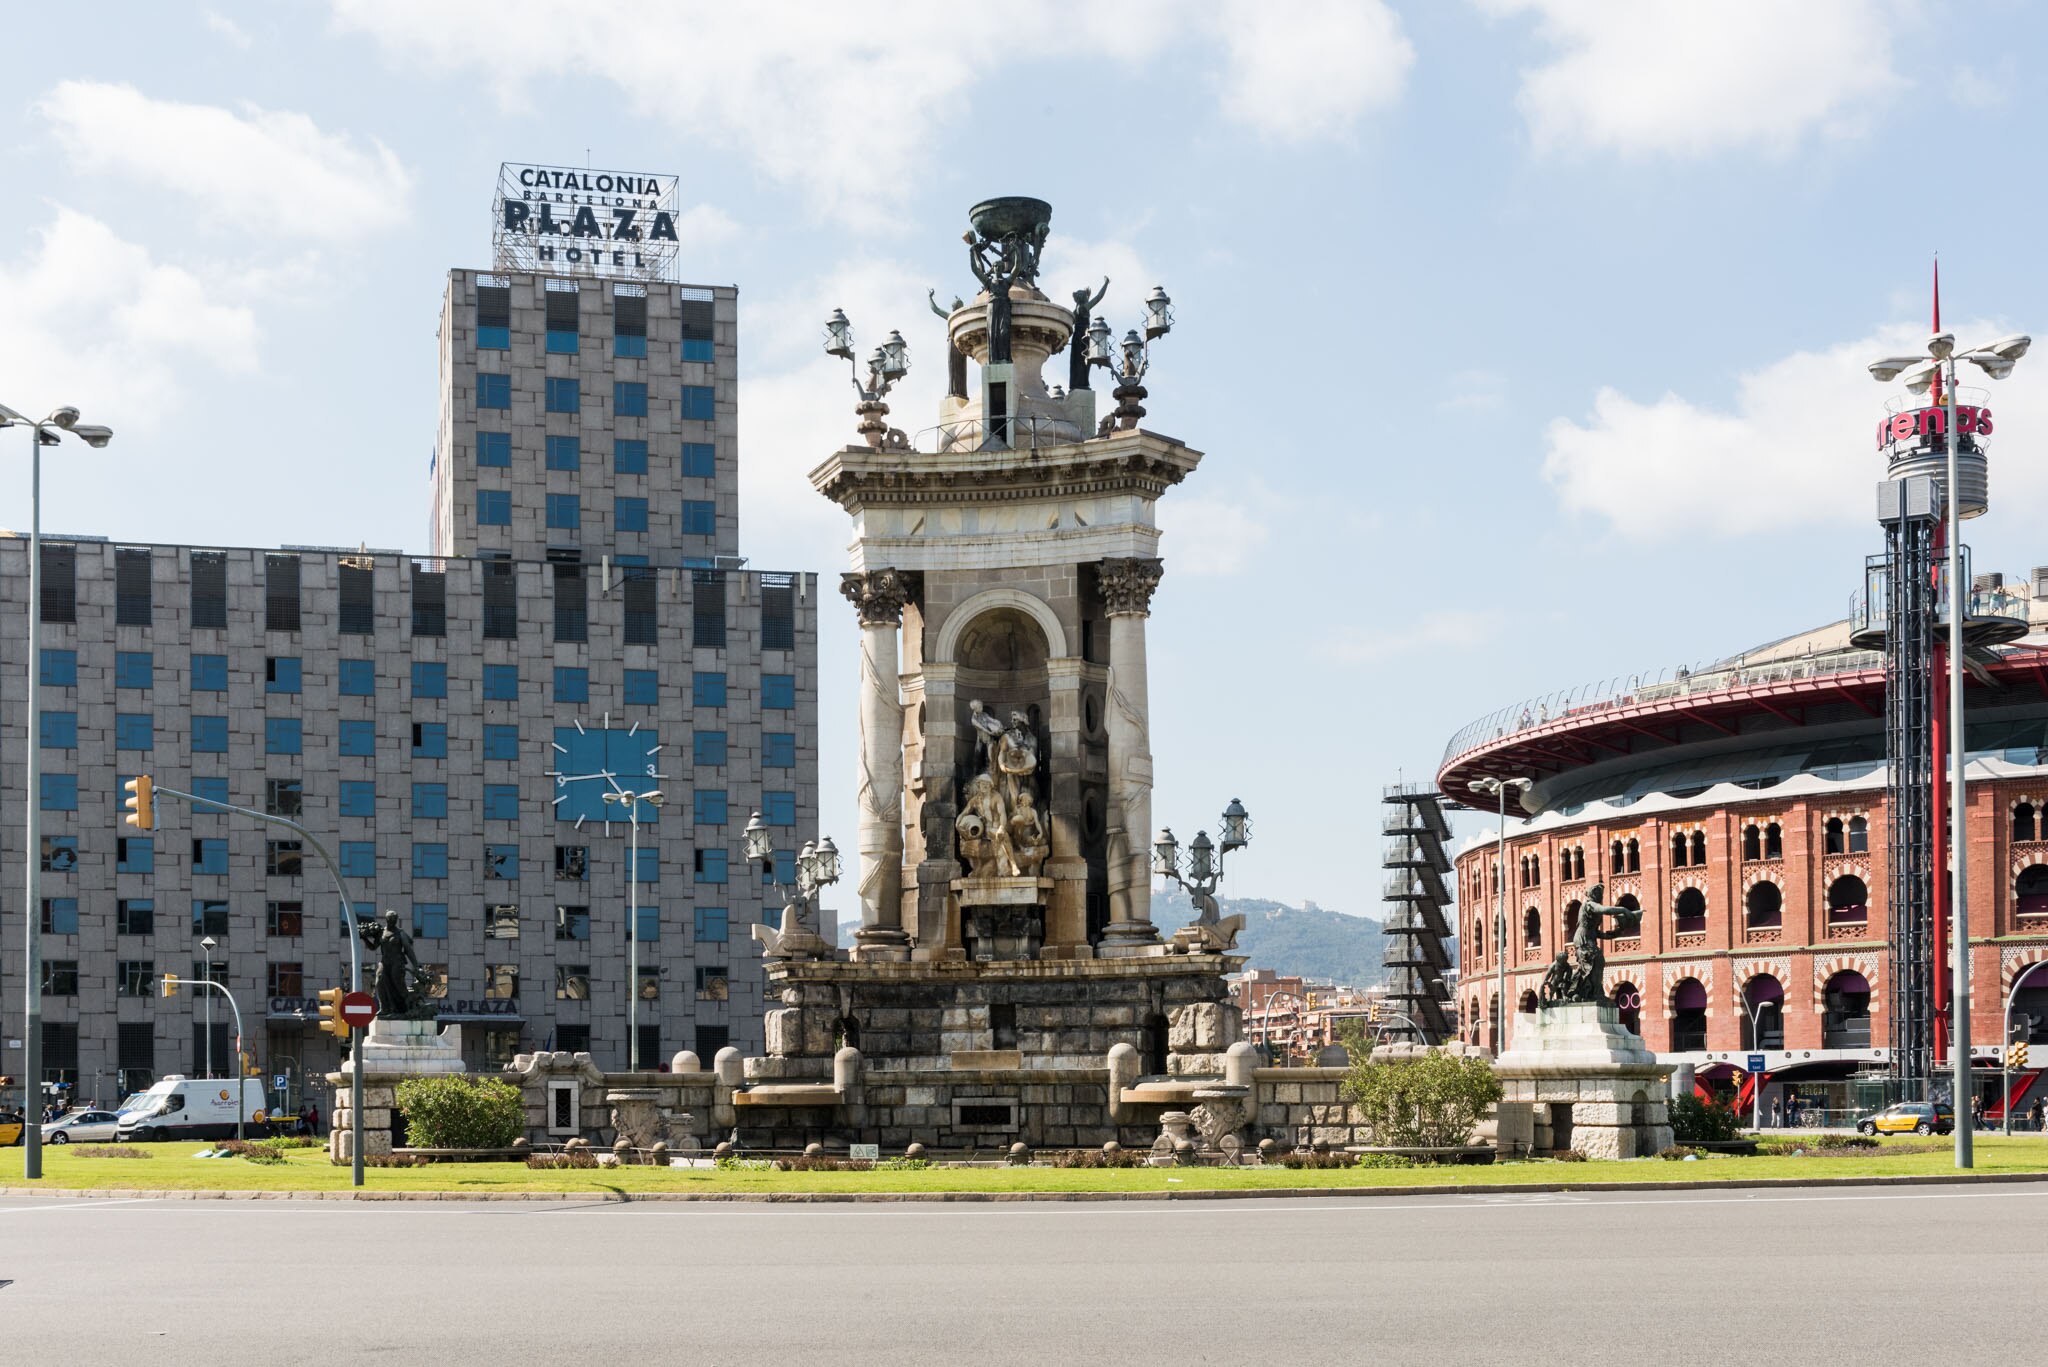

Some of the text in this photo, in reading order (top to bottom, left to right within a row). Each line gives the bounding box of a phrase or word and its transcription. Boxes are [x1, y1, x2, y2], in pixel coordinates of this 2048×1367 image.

[520, 169, 660, 196] CATALONIA
[523, 190, 657, 210] BARCELONA
[504, 200, 679, 241] PLAZA
[538, 245, 645, 268] HOTEL
[457, 1000, 517, 1014] PLAZA
[276, 1076, 285, 1087] P
